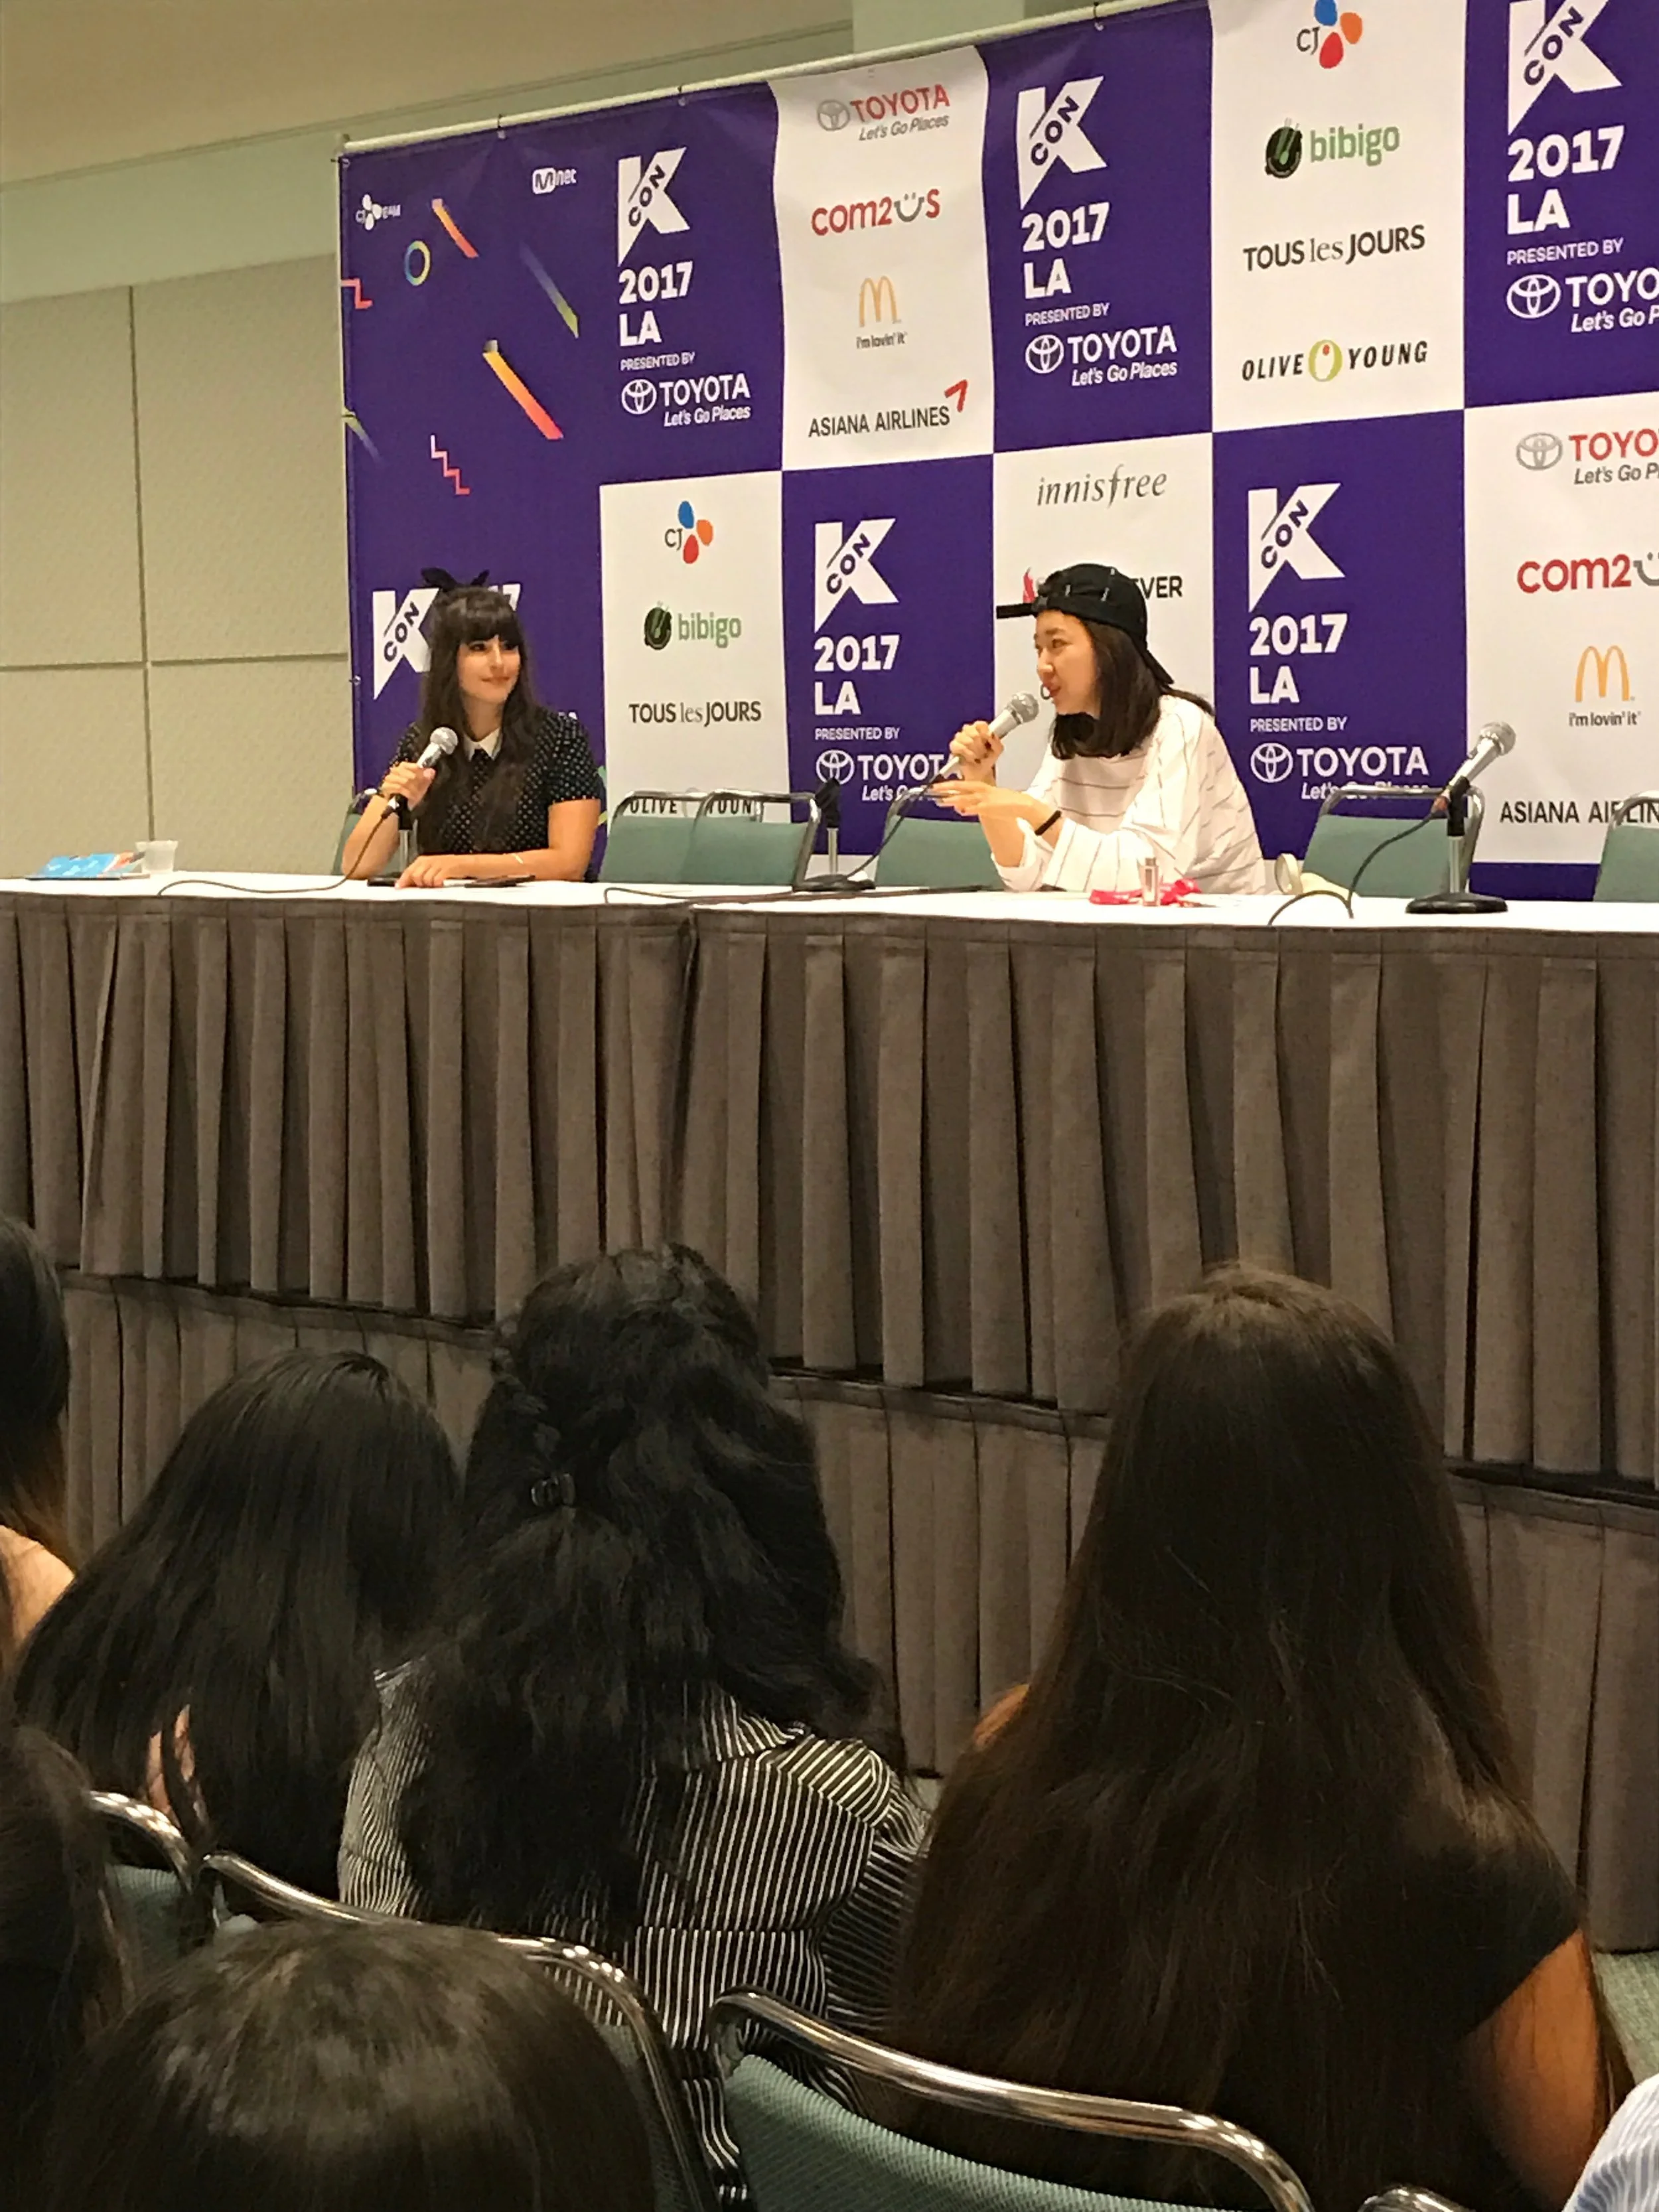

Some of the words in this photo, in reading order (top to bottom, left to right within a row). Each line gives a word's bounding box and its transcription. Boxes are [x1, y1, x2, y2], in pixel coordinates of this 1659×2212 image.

[1296, 27, 1321, 55] CJ
[850, 84, 950, 122] TOYOTA
[859, 124, 888, 141] Let's
[891, 121, 908, 137] Go
[909, 115, 950, 133] Places
[1310, 123, 1400, 167] bibigo
[1508, 125, 1624, 182] 2017
[533, 167, 577, 194] Mnet
[1022, 202, 1110, 252] 2017
[1508, 188, 1571, 235] LA
[1243, 240, 1305, 271] TOUS
[1310, 238, 1344, 262] les
[1345, 224, 1425, 265] JOURS
[1507, 242, 1599, 265] PRESENTED
[1603, 237, 1624, 255] BY
[618, 261, 693, 304] 2017
[1024, 258, 1072, 299] LA
[1565, 267, 1659, 307] TOYO
[619, 311, 662, 346] LA
[1025, 305, 1090, 327] PRESENTED
[1092, 302, 1110, 318] BY
[1571, 310, 1615, 332] Let's
[1619, 307, 1646, 328] Go
[1068, 325, 1177, 364] TOYOTA
[1242, 353, 1304, 381] OLIVE
[1348, 340, 1427, 370] YOUNG
[620, 354, 680, 372] PRESENTED
[681, 352, 695, 364] BY
[1072, 367, 1103, 386] Let's
[1107, 364, 1128, 382] Go
[1130, 361, 1178, 381] Places
[659, 373, 751, 407] TOYOTA
[664, 409, 691, 428] Let's
[693, 407, 710, 423] Go
[711, 405, 751, 421] Places
[808, 413, 870, 437] ASIANA
[875, 406, 950, 431] AIRLINES
[1569, 429, 1659, 461] TOYO
[1037, 463, 1167, 509] innisfree
[1574, 466, 1613, 484] Let's
[1618, 465, 1642, 482] Go
[664, 528, 683, 552] CJ
[678, 612, 742, 648] bibigo
[1249, 613, 1348, 656] 2017
[814, 634, 900, 672] 2017
[814, 681, 861, 715] LA
[1250, 666, 1300, 704] LA
[629, 703, 676, 723] TOUS
[680, 701, 703, 723] les
[703, 701, 762, 727] JOURS
[1250, 717, 1324, 732] PRESENTED
[1327, 716, 1348, 731] BY
[815, 727, 883, 741] PRESENTED
[884, 727, 900, 740] BY
[1296, 746, 1429, 777] TOYOTA
[630, 798, 678, 814] OLIVE
[861, 784, 894, 802] Let's
[1500, 800, 1580, 824] ASIANA
[1588, 800, 1659, 824] AILIN
